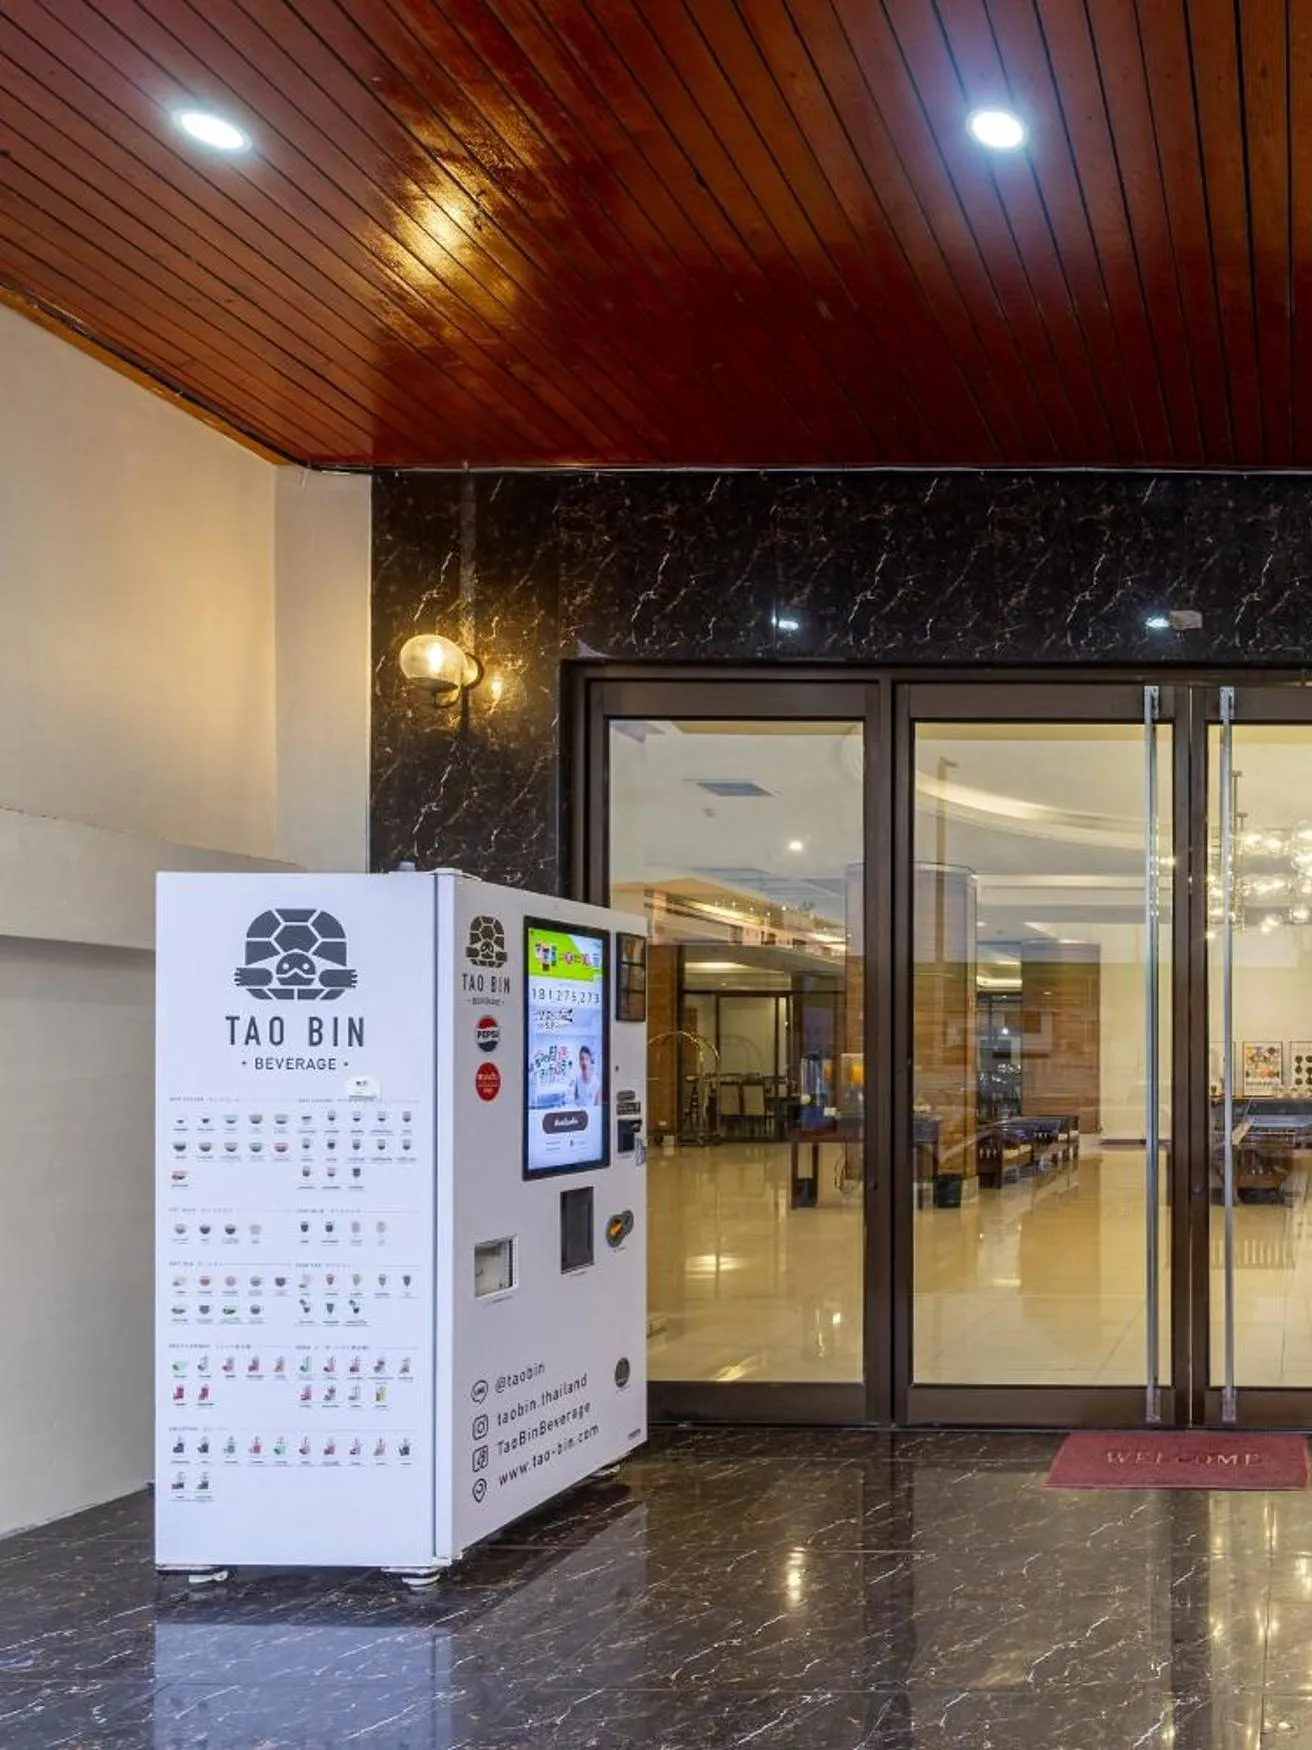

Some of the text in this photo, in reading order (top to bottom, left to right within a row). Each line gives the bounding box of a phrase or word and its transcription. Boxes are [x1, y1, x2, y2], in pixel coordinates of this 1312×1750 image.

[462, 973, 484, 992] TAO
[225, 1016, 364, 1047] TAO BIN
[255, 1057, 337, 1070] BEVERAGE
